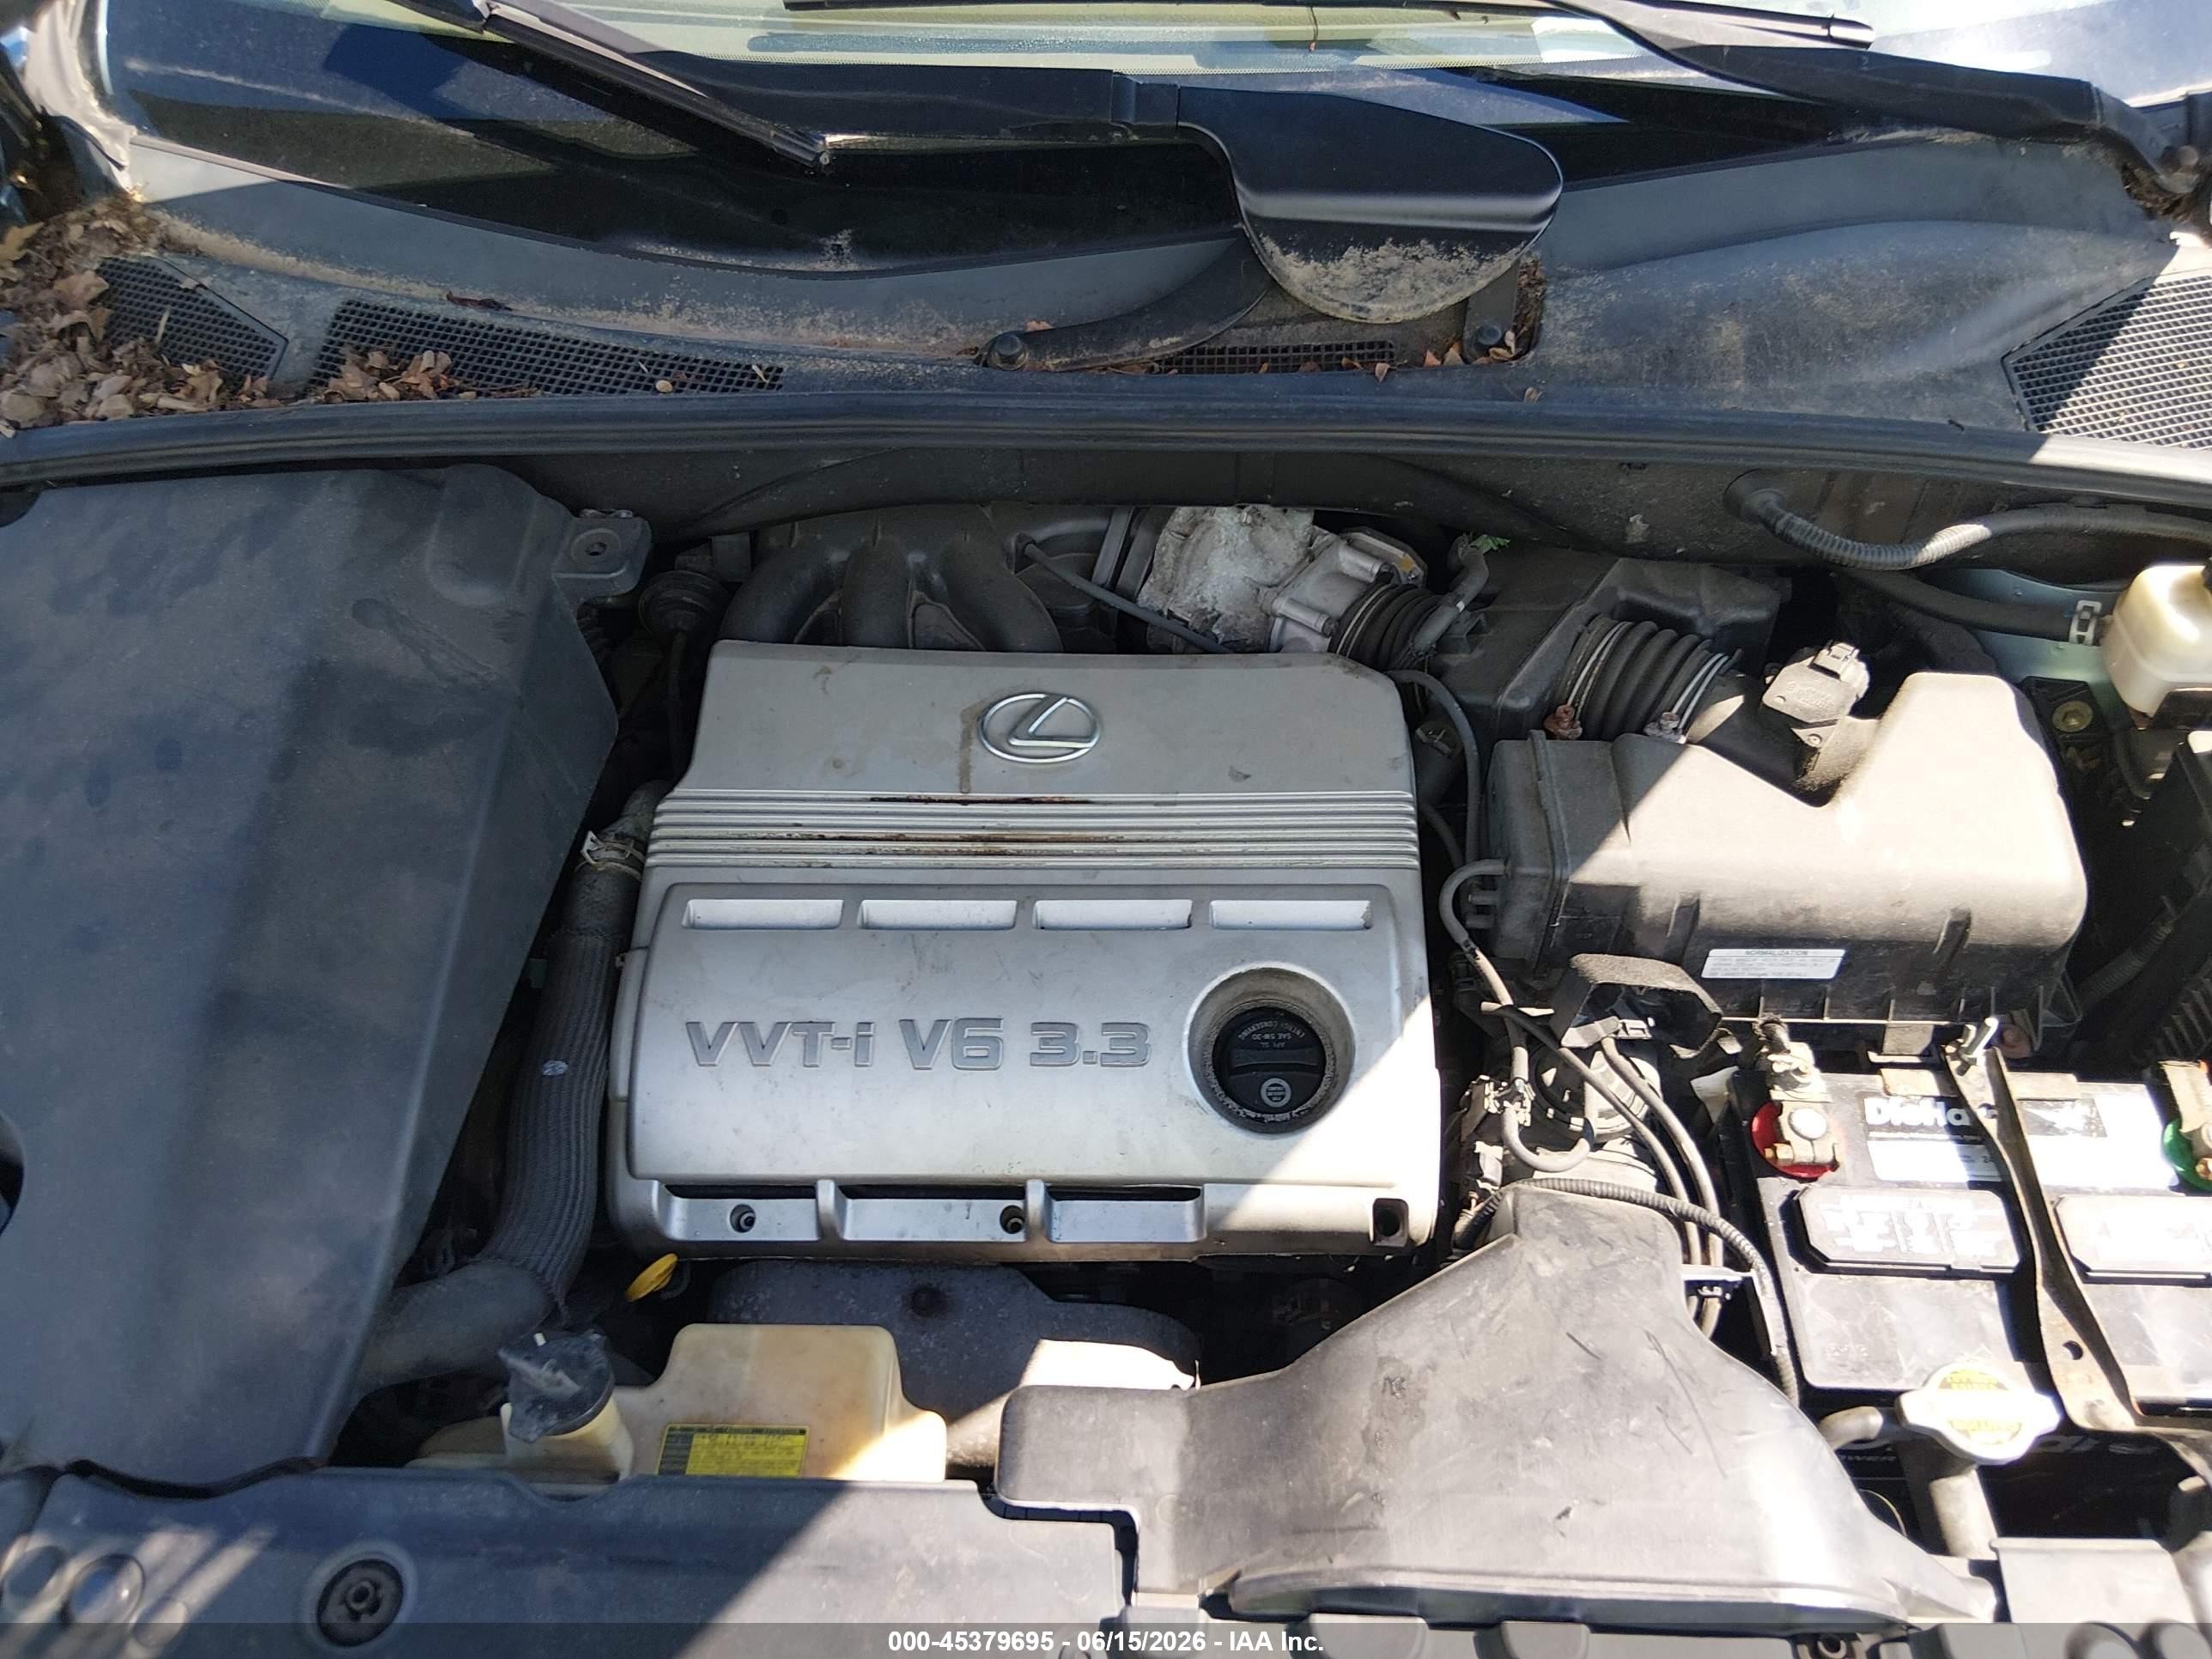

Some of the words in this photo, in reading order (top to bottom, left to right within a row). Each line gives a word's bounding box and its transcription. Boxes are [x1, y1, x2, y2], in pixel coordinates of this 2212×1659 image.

[686, 1022, 875, 1067] VVT-i
[898, 1018, 1004, 1071] V6
[1030, 1022, 1149, 1067] 3.3
[1864, 1097, 1972, 1127] DieHa
